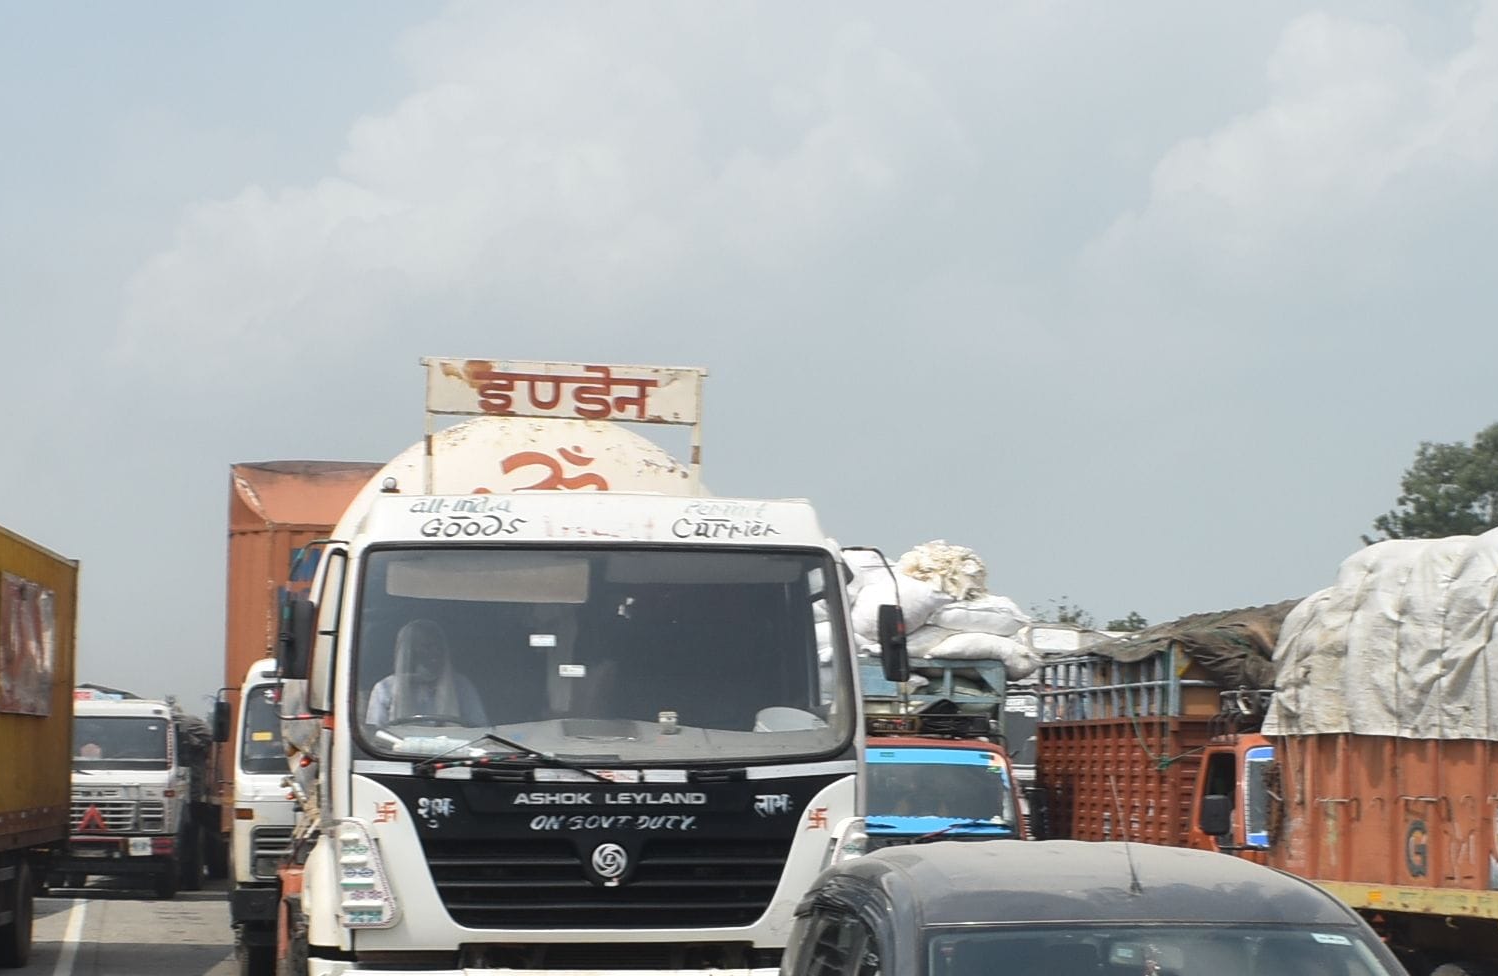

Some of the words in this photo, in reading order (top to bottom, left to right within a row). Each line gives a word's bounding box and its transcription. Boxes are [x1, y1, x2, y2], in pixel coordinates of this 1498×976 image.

[472, 365, 659, 420] इण्डेन
[513, 793, 593, 805] ASHOK
[605, 793, 707, 805] LEYLAND
[530, 815, 565, 830] ON
